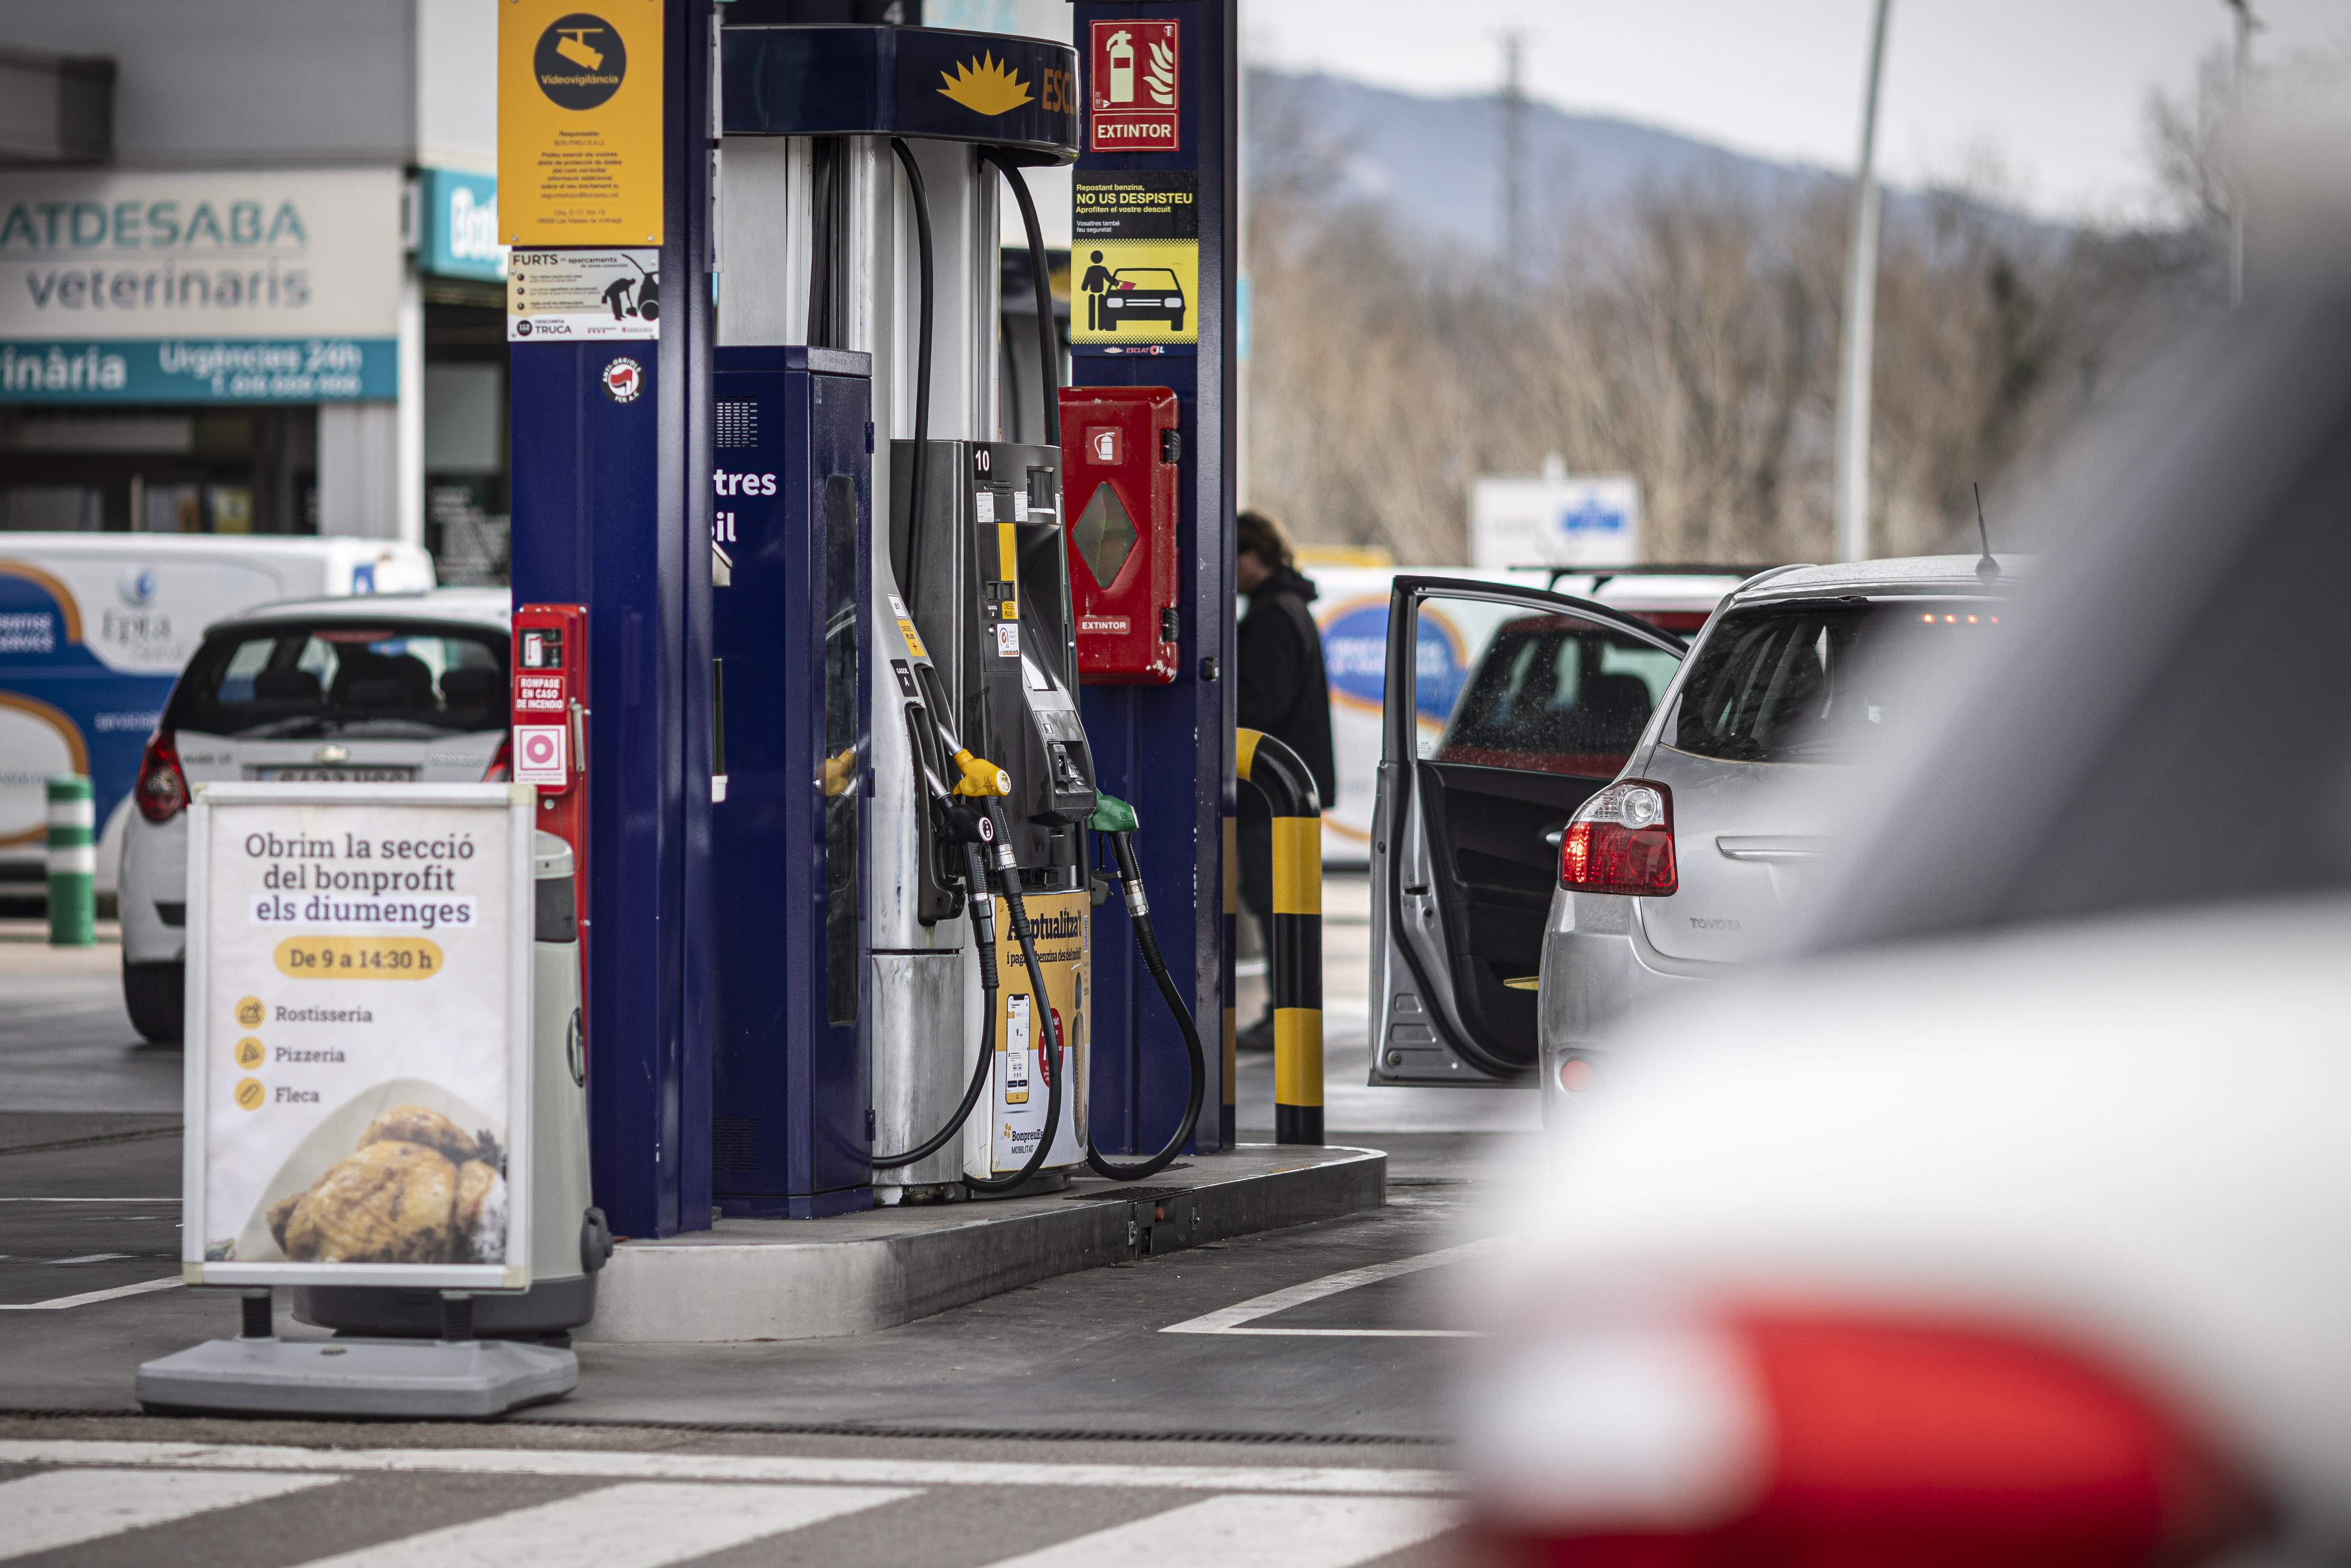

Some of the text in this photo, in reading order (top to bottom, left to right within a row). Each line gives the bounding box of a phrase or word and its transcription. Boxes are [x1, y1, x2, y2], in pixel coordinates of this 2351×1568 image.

[541, 74, 619, 86] Videovigilància
[1098, 124, 1171, 138] EXTINTOR
[1076, 193, 1192, 204] NO US DESPISTEU
[513, 254, 558, 265] FURTS
[26, 259, 310, 310] veterinaris
[534, 326, 572, 335] TRUCA
[975, 450, 989, 471] 10
[713, 469, 777, 495] tres
[712, 512, 736, 542] il
[521, 678, 560, 689] ROMPASE
[904, 676, 910, 686] A
[522, 689, 559, 699] EN CASO
[517, 698, 562, 709] DE INCENDIO
[245, 833, 474, 860] Obrim la secció
[264, 865, 455, 895] del bonprofit
[256, 896, 470, 928] els diumenges
[1690, 917, 1744, 930] TOYOTA
[290, 949, 433, 969] De 9 a 14:30 h
[1007, 951, 1009, 964] i
[275, 1006, 373, 1023] Rostisseria
[275, 1047, 346, 1063] Pizzeria
[275, 1086, 320, 1103] Fleca
[1012, 1145, 1034, 1154] MOBILITAT
